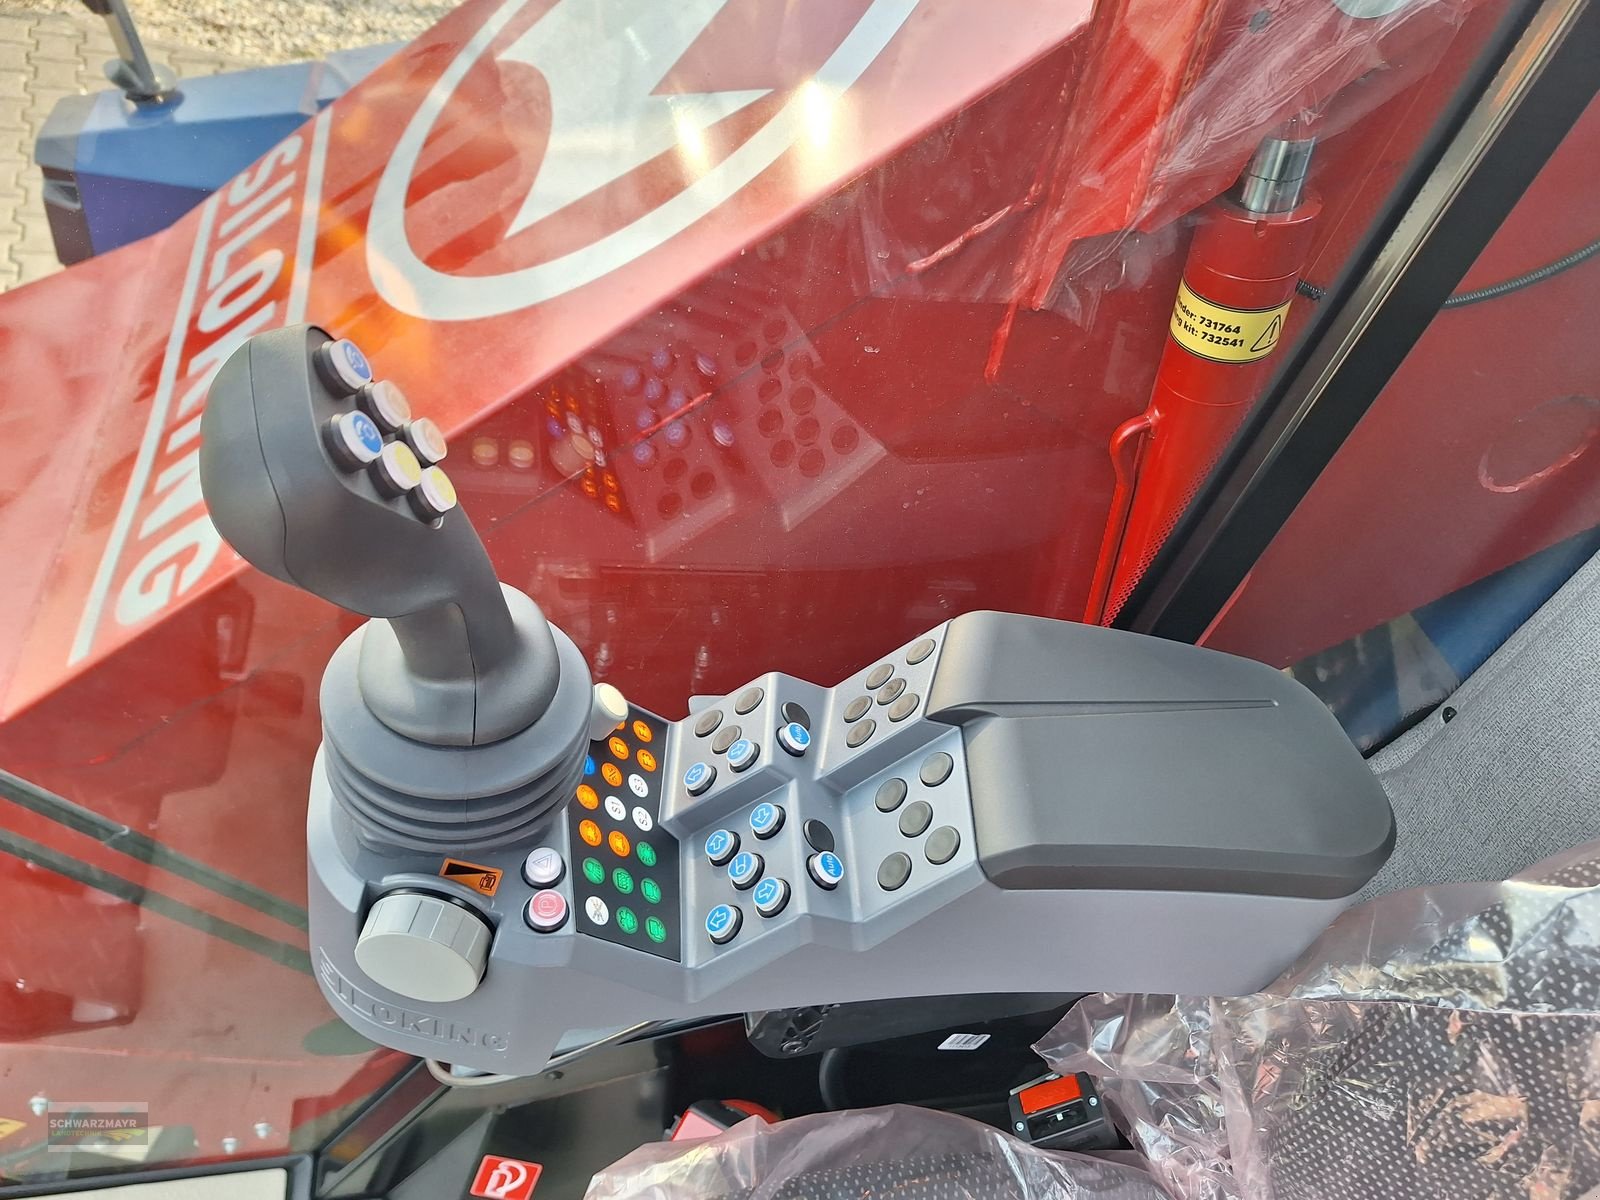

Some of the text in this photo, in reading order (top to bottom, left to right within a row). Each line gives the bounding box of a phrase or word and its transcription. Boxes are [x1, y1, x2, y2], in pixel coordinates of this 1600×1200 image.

[1183, 320, 1198, 337] kit:
[1201, 331, 1244, 347] 732541
[1199, 315, 1241, 335] 731764
[827, 855, 836, 876] Auto
